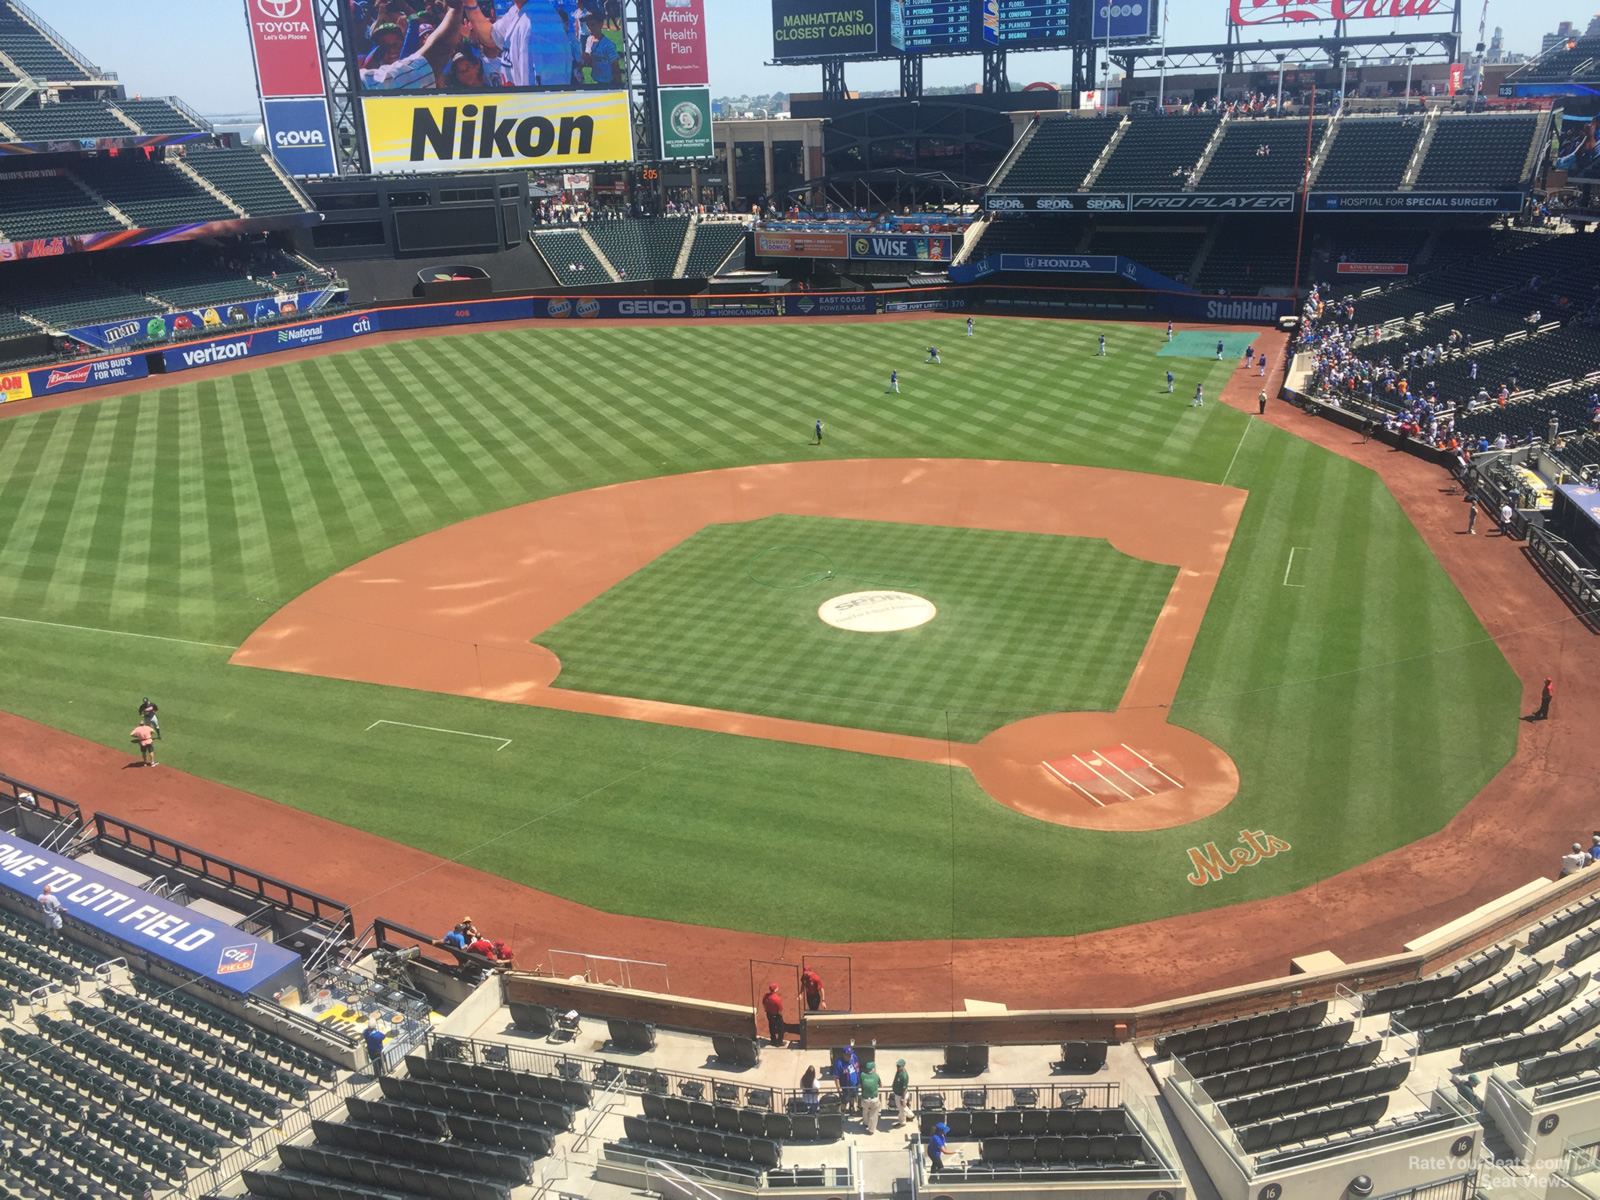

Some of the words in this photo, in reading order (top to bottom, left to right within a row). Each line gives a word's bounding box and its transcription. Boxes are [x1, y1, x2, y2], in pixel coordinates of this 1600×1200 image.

[660, 12, 698, 26] Affinity
[784, 10, 864, 27] MANHATTAN'S
[256, 22, 310, 32] TOYOTA
[775, 27, 826, 41] CLOSEST
[828, 23, 874, 38] CASINO
[664, 28, 698, 40] Health
[670, 42, 692, 54] Plan
[275, 130, 325, 146] GOYA
[410, 104, 594, 162] Nikon
[80, 140, 96, 148] VS
[1134, 198, 1187, 208] PRO
[1188, 198, 1292, 208] PLAYER
[1340, 198, 1383, 206] HOSPITAL
[1406, 198, 1448, 206] SPECIAL
[1450, 198, 1499, 207] SURGERY
[27, 238, 64, 258] Mets
[1038, 259, 1091, 268] HONDA
[550, 302, 570, 314] Gulf
[578, 302, 598, 314] Gulf
[618, 300, 686, 314] GEICO
[1207, 300, 1278, 320] StubHub!
[353, 318, 370, 333] citi
[288, 325, 322, 340] National
[183, 340, 248, 366] verizon
[94, 360, 110, 371] THIS
[110, 358, 132, 368] BUD'S
[50, 371, 88, 384] Budweiser
[95, 372, 109, 380] FOR
[110, 368, 126, 378] YOU.
[1186, 829, 1292, 886] Mets
[32, 866, 82, 892] TO
[66, 882, 136, 917] CITI
[118, 904, 216, 952] FIELD
[220, 962, 250, 972] FIELD
[1545, 1119, 1554, 1129] 15
[1458, 1142, 1467, 1152] 16
[1266, 1188, 1276, 1199] 16
